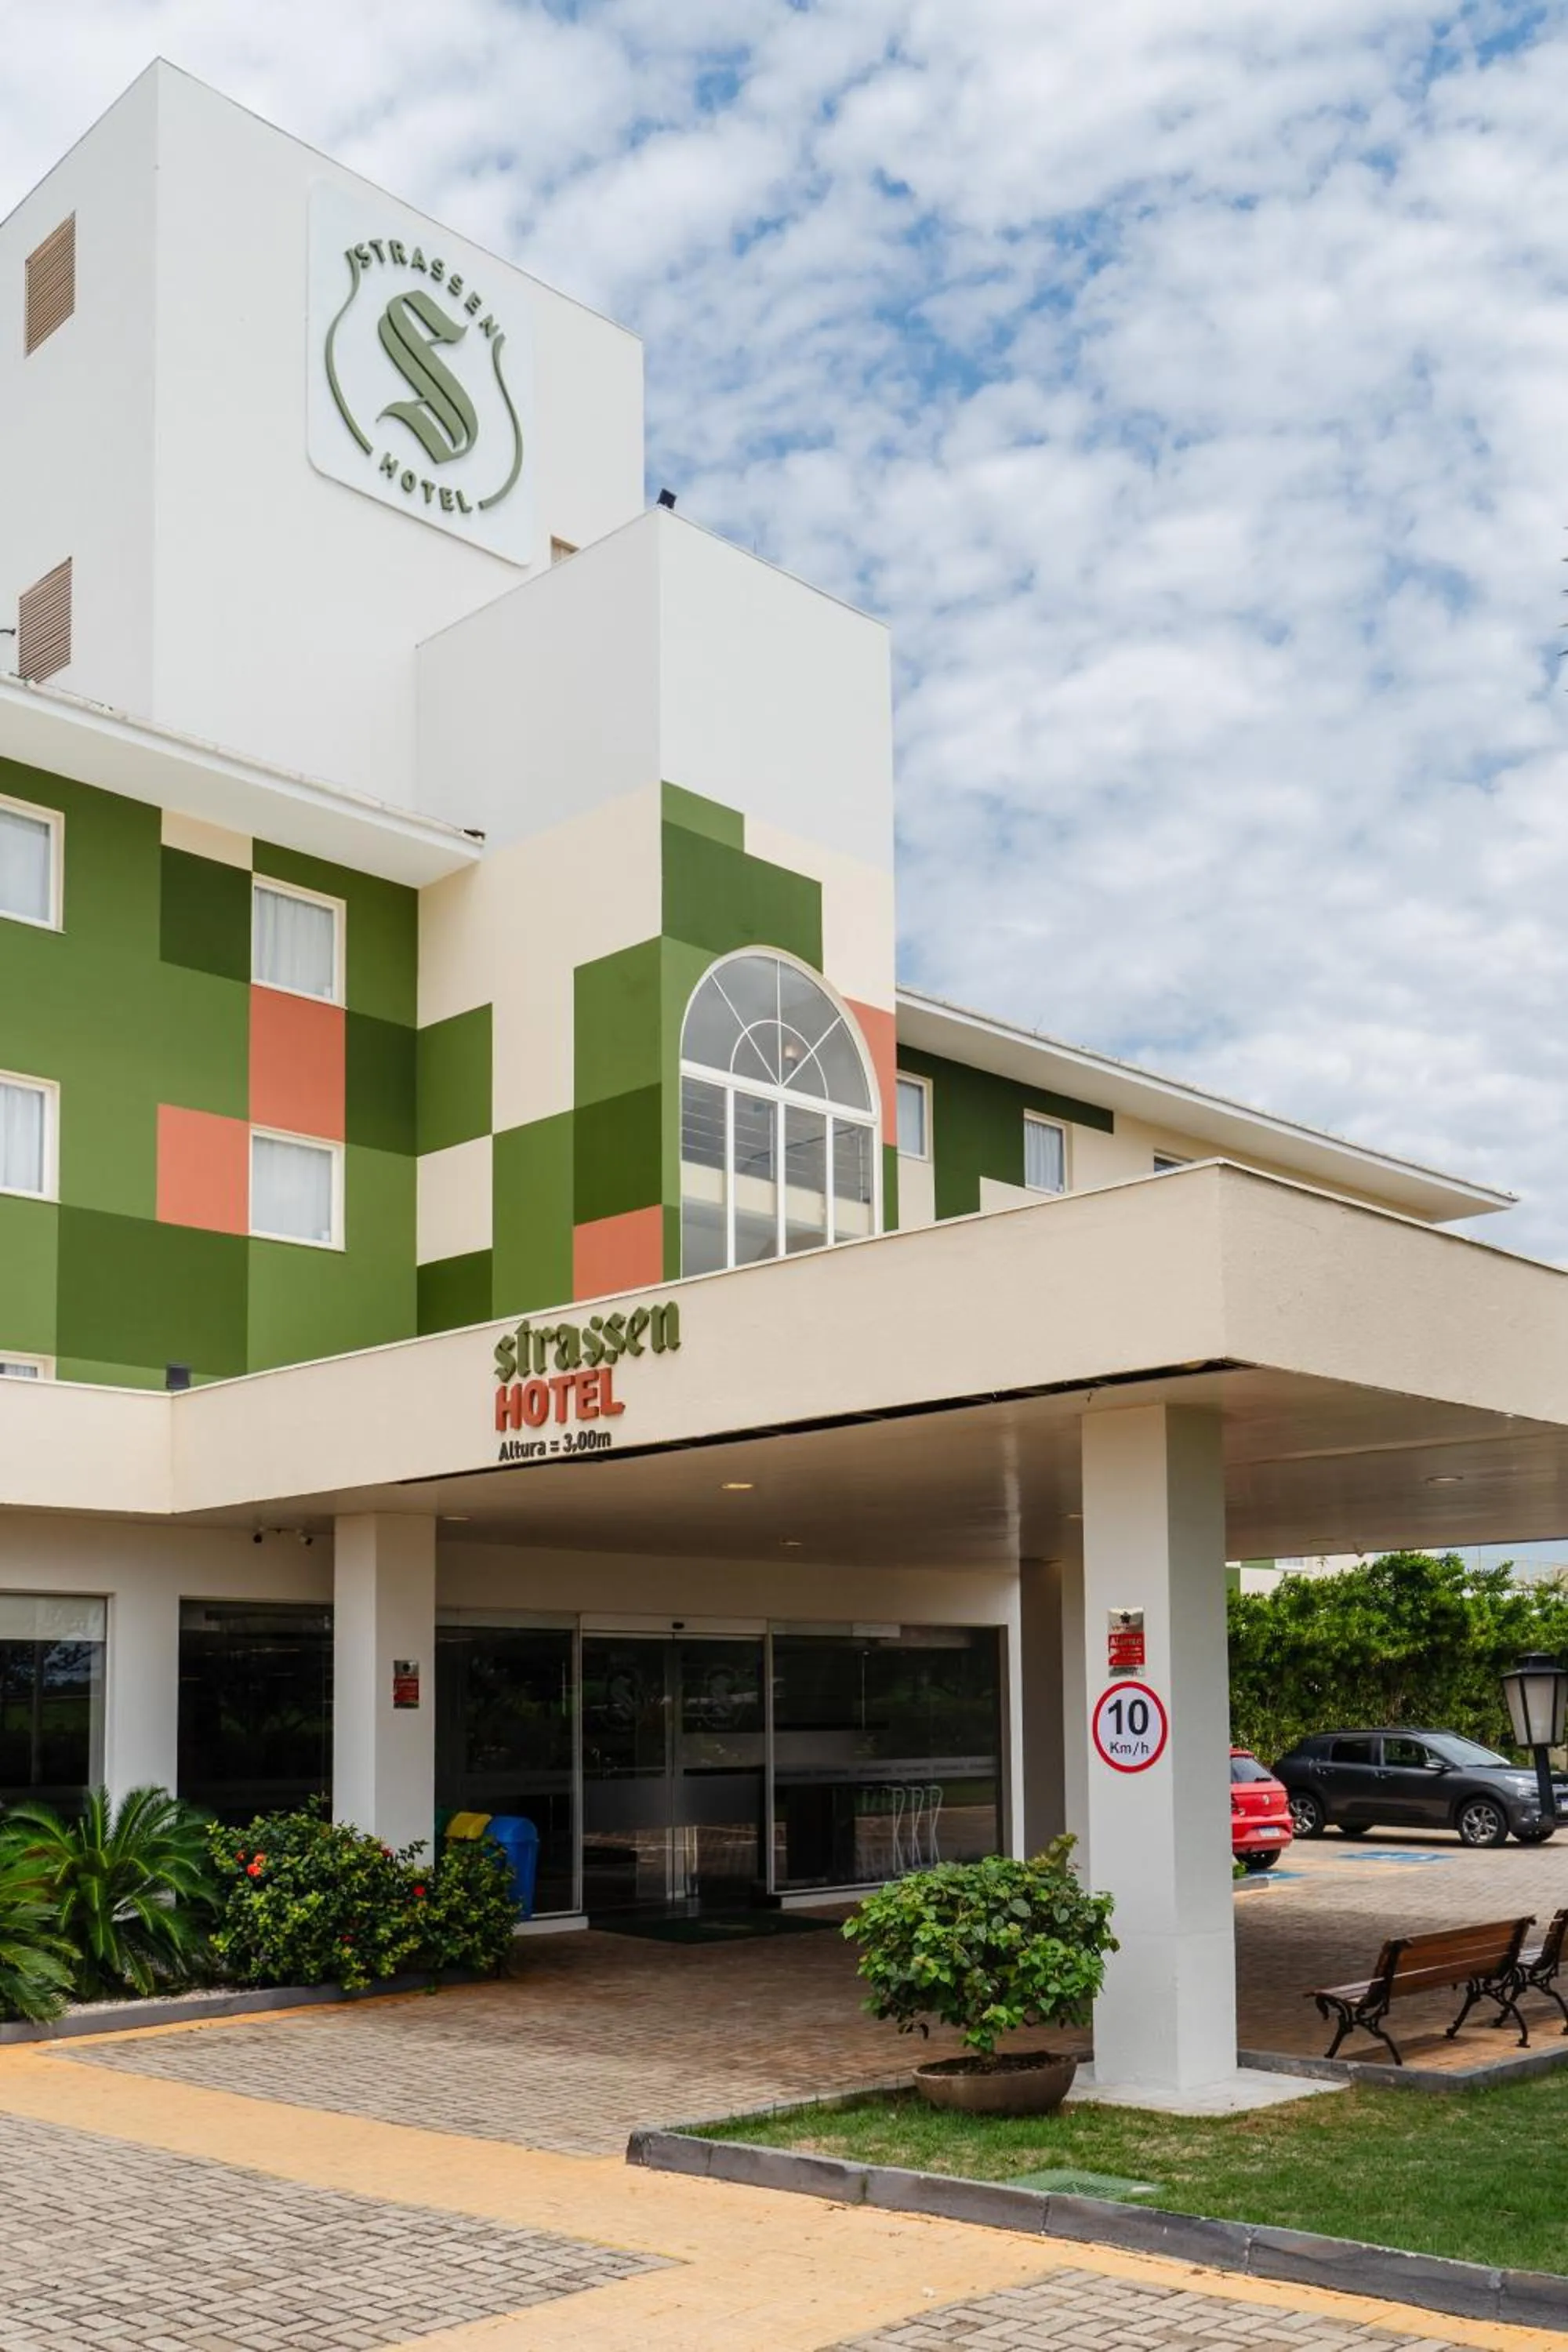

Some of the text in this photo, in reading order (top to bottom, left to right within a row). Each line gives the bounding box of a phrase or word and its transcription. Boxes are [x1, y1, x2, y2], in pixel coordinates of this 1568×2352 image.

[354, 238, 499, 339] STRASSEN
[379, 452, 472, 513] HOTEL
[494, 1301, 681, 1383] strassen
[495, 1367, 626, 1432] HOTEL
[499, 1440, 546, 1461] Altura
[563, 1430, 612, 1451] 3,00m
[1108, 1699, 1149, 1736] 10
[1109, 1741, 1149, 1755] Km/h
